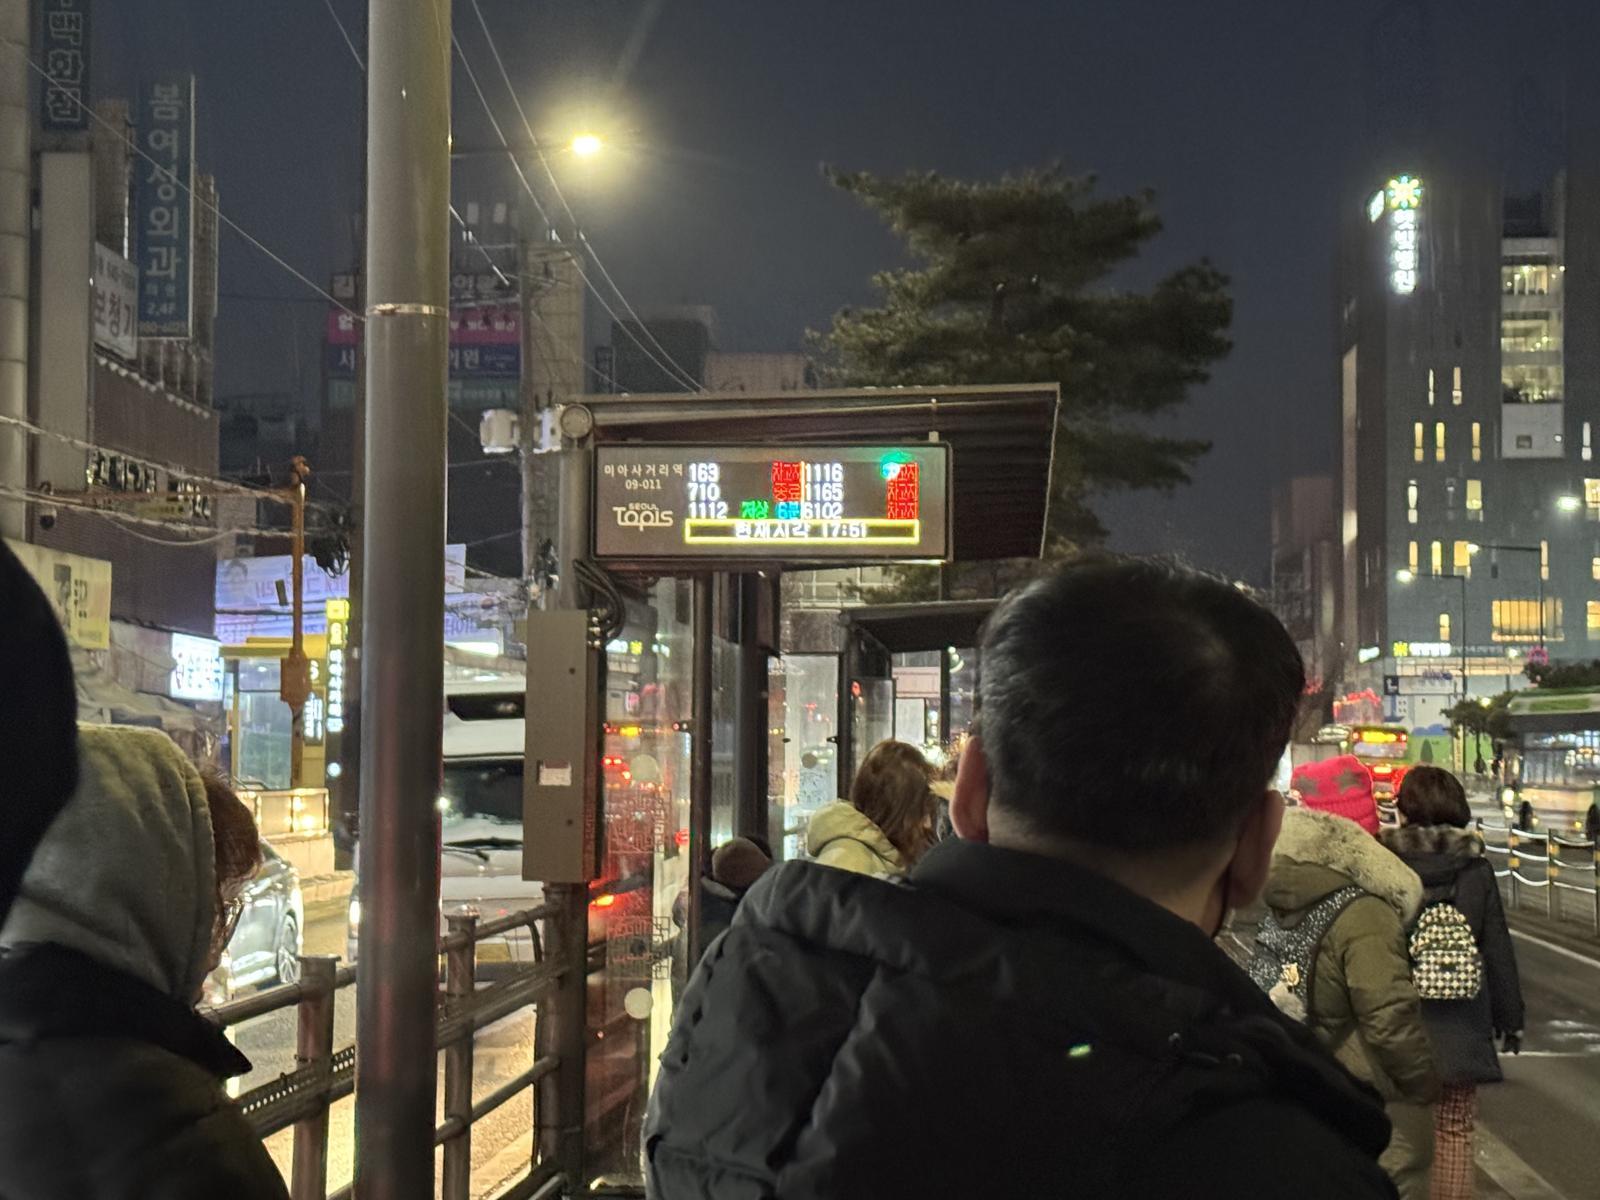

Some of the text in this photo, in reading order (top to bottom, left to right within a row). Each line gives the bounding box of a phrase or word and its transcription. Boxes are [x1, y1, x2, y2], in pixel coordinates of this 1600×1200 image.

[47, 0, 82, 120] 백화점
[804, 463, 844, 482] 1116
[625, 479, 662, 490] 09-011
[687, 482, 721, 501] 710
[804, 482, 844, 501] 1165
[887, 482, 918, 500] 차고지
[688, 501, 729, 519] 1112
[803, 501, 844, 519] 6102
[887, 500, 918, 519] 차고지
